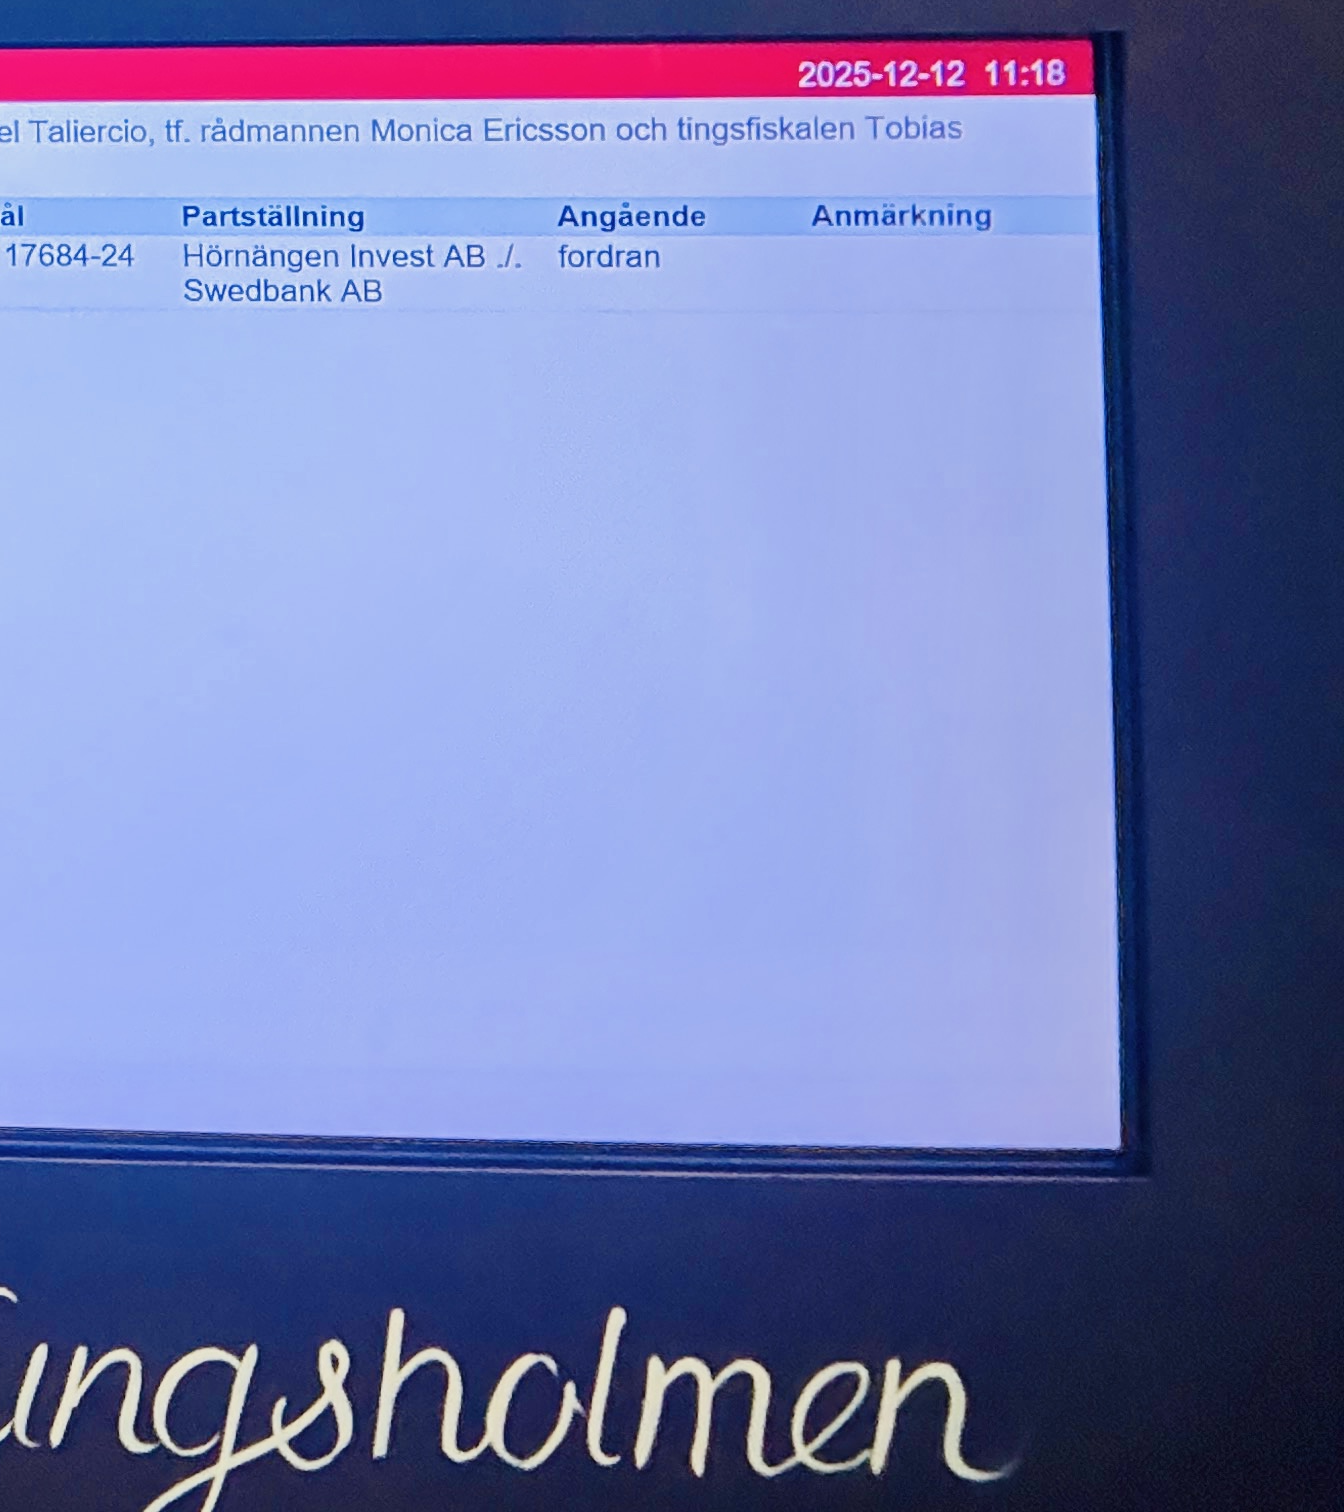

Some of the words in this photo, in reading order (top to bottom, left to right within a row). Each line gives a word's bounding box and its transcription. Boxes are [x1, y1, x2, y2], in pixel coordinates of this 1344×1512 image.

[798, 59, 965, 88] 2025-12-12
[984, 58, 1066, 86] 11:18
[28, 118, 155, 147] Taliercio,
[165, 119, 191, 143] tf.
[200, 117, 360, 143] rådmannen
[371, 117, 473, 142] Monica
[484, 117, 606, 142] Ericsson
[616, 116, 667, 142] och
[677, 116, 855, 147] tingsfiskalen
[864, 115, 962, 140] Tobias
[182, 204, 364, 233] Partställning
[557, 202, 706, 233] Angående
[811, 204, 991, 231] Anmärkning
[6, 243, 135, 267] 17684-24
[183, 243, 340, 273] Hörnängen
[350, 243, 435, 268] Invest
[443, 244, 486, 268] AB
[496, 243, 522, 269] ./.
[558, 244, 660, 268] fordran
[183, 278, 332, 303] Swedbank
[340, 279, 382, 303] AB
